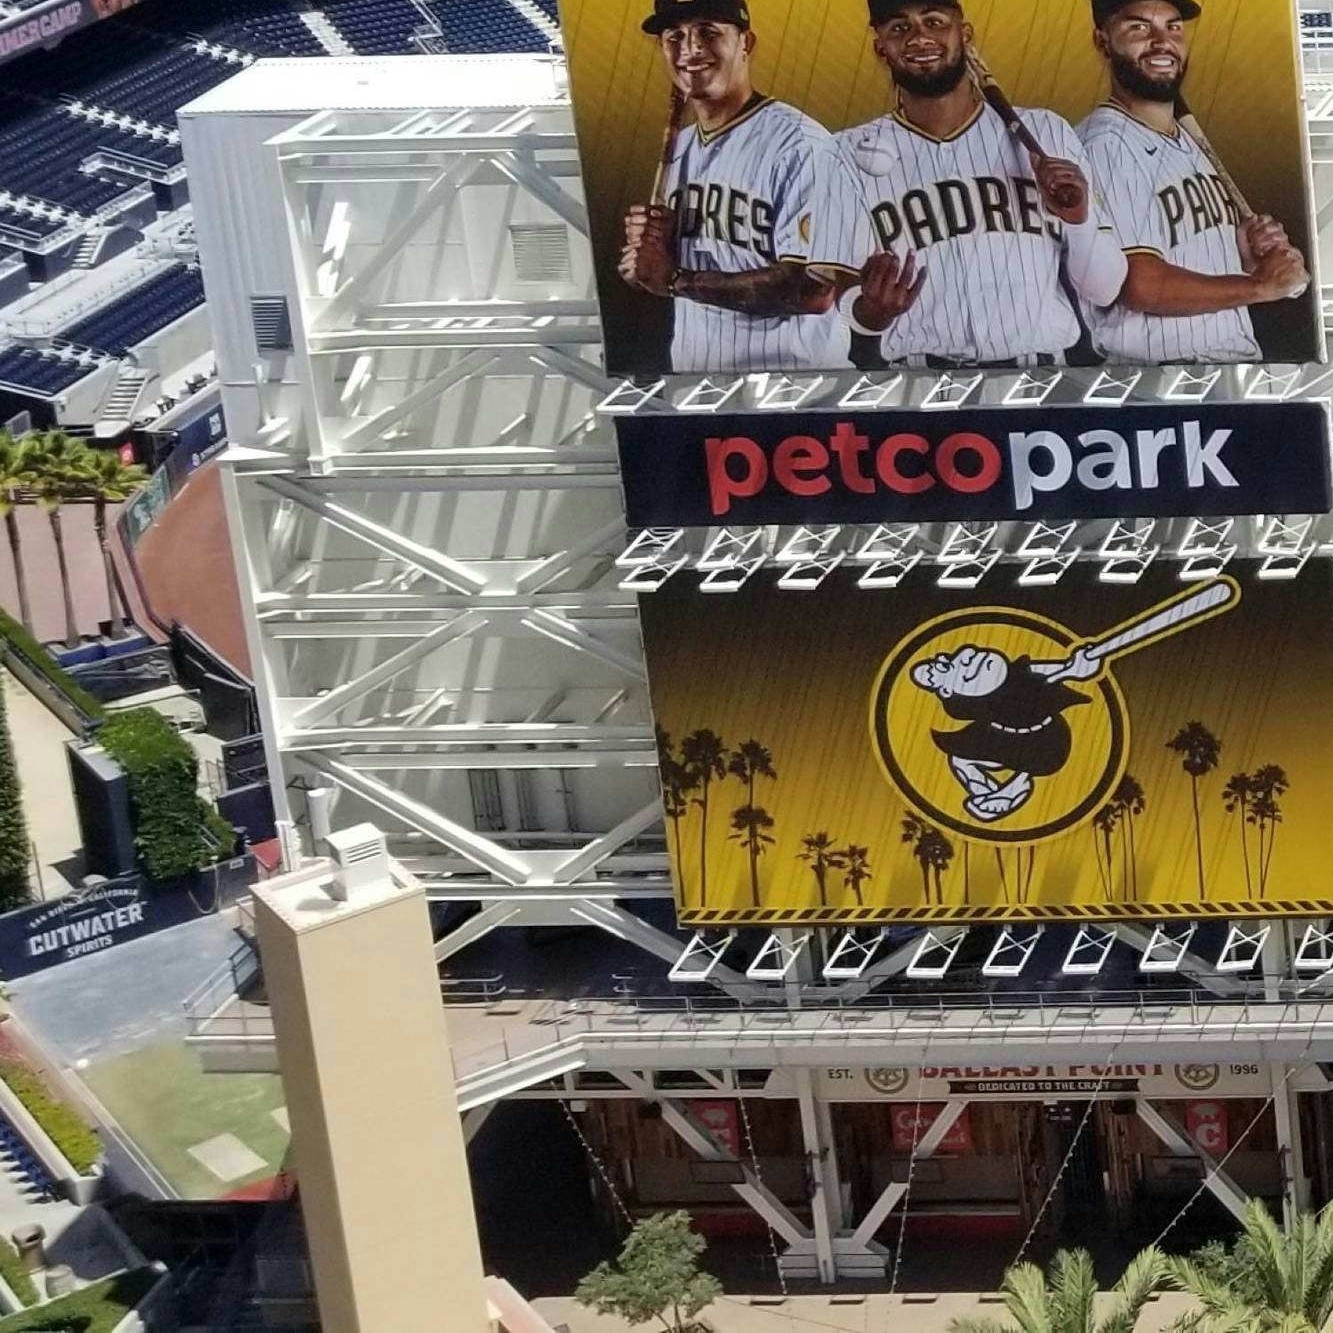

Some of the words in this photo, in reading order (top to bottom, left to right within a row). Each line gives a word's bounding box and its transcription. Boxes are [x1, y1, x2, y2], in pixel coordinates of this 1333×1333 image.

[704, 422, 1001, 516] petco
[1007, 420, 1240, 511] park
[29, 903, 144, 956] CUTWATER
[67, 935, 113, 958] SPIRITS
[827, 1068, 853, 1079] EST.
[1229, 1064, 1259, 1075] 1996
[978, 1081, 1036, 1091] DEDICATED
[1037, 1081, 1051, 1091] TO
[1054, 1081, 1076, 1091] THE
[1077, 1081, 1111, 1091] CRAFT
